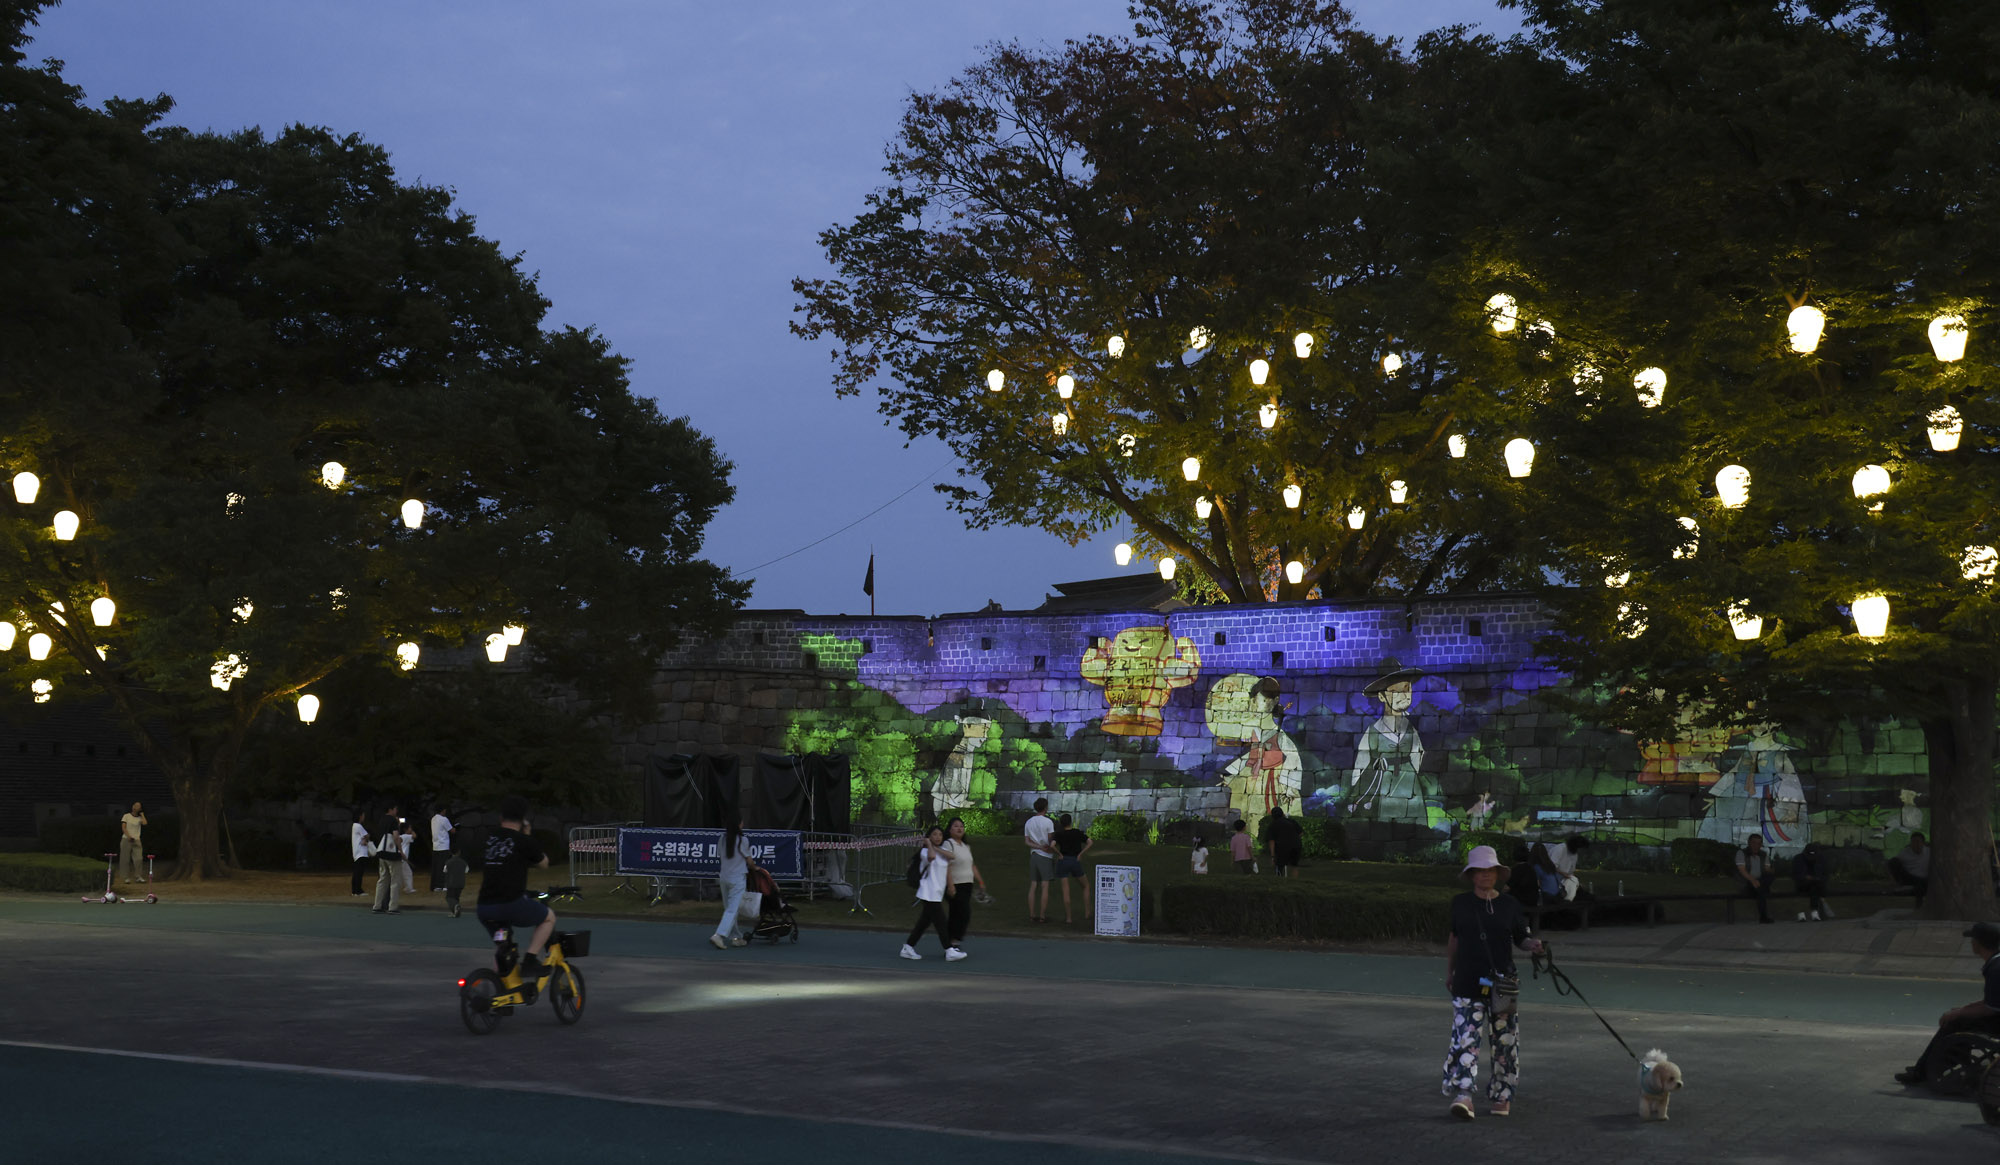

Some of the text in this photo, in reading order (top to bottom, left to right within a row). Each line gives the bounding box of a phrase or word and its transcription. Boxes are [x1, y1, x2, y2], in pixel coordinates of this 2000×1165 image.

[651, 841, 776, 859] 수원화성 미아트
[651, 855, 678, 863] Suwon
